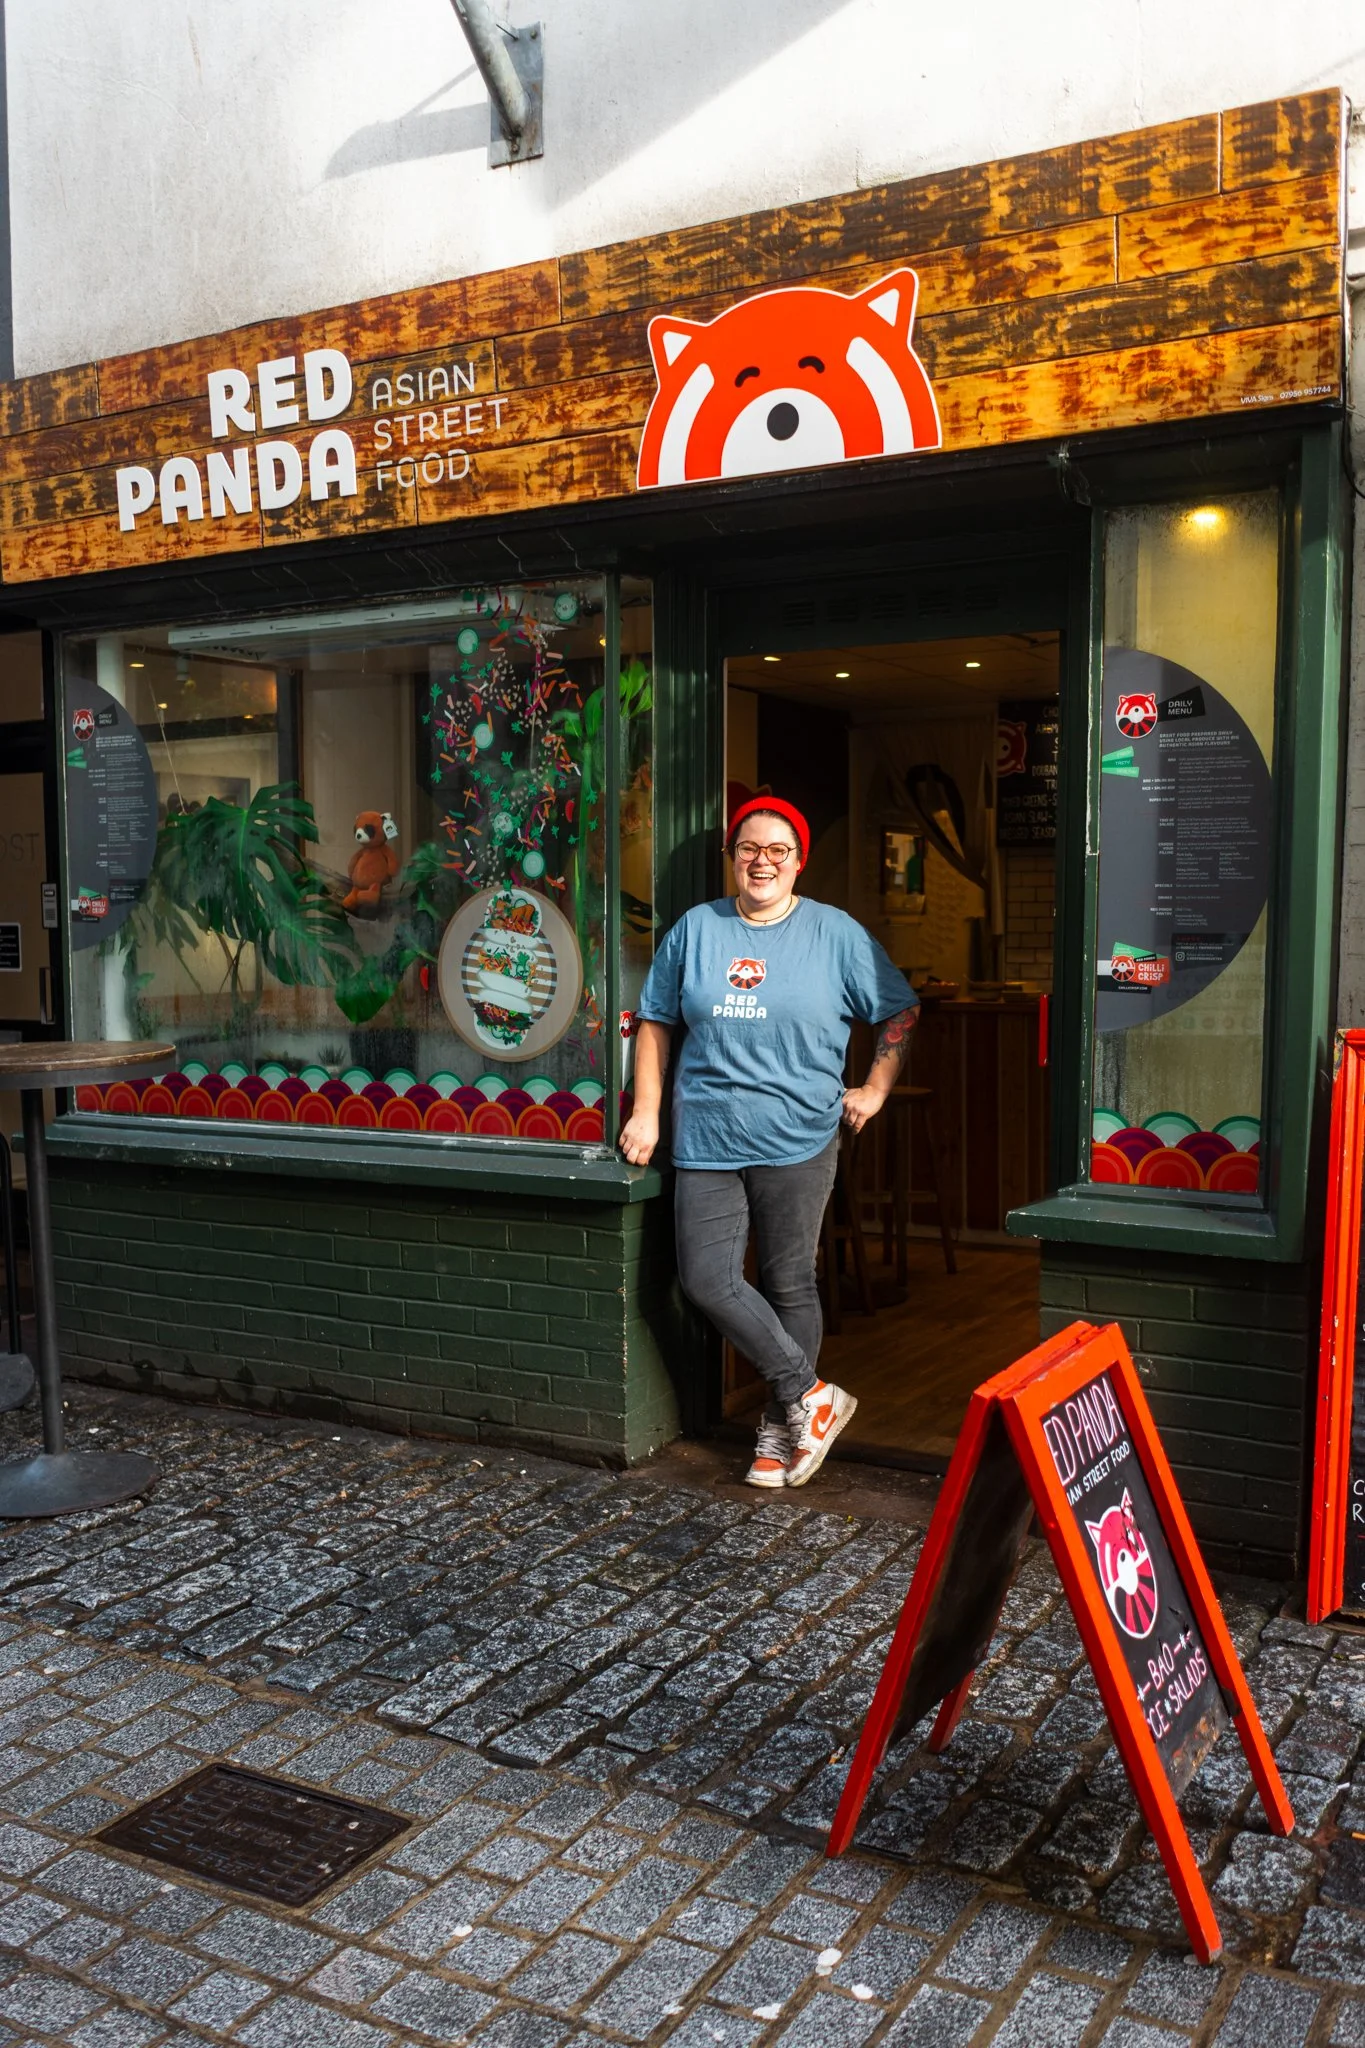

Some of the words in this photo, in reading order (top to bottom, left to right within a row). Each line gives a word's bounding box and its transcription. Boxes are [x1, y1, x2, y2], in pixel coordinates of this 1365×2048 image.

[207, 348, 353, 439] RED
[372, 362, 475, 410] ASIAN
[374, 397, 508, 451] STREET
[116, 429, 358, 532] PANDA
[376, 448, 470, 491] FOOD
[1167, 700, 1193, 708] DAILY
[1167, 707, 1193, 715] MENU
[712, 1005, 767, 1019] PANDA
[725, 993, 758, 1007] RED
[1065, 1377, 1125, 1465] PANDA
[1082, 1456, 1111, 1493] STREET
[1110, 1441, 1130, 1467] FOOD
[1147, 1642, 1175, 1690] BAO
[1147, 1700, 1170, 1739] CE
[1168, 1647, 1207, 1714] SALADS
